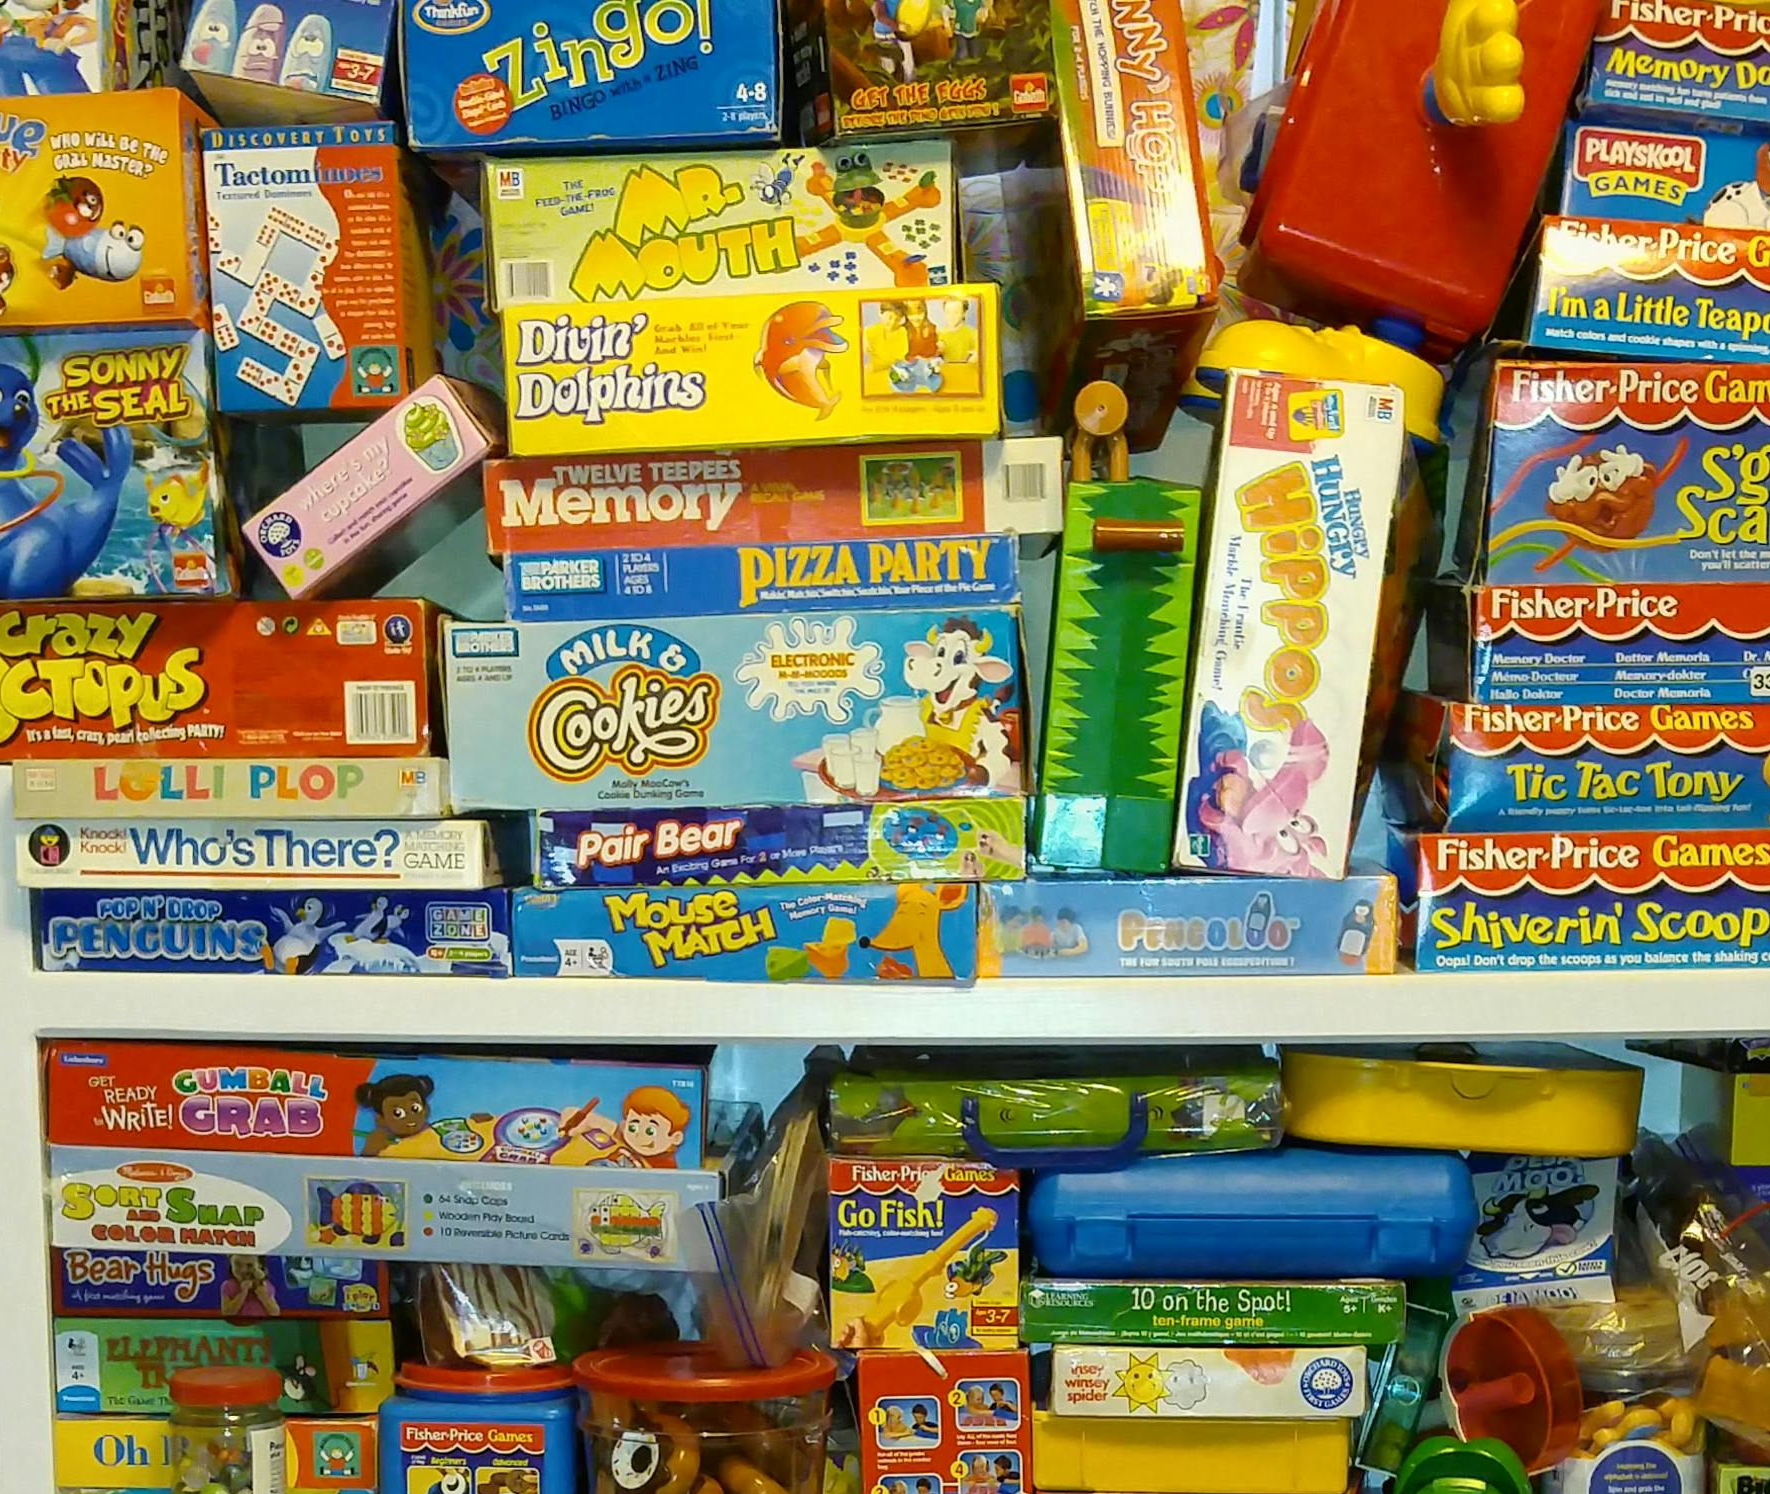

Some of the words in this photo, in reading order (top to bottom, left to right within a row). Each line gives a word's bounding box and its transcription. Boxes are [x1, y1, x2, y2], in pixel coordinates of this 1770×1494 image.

[736, 83, 767, 103] 4-8
[210, 128, 326, 148] DISCOVERY
[332, 126, 386, 145] TOYS
[214, 162, 382, 189] Tactominoes
[613, 163, 744, 249] MR.
[568, 218, 802, 302] MOUTH
[1547, 291, 1575, 319] I'm
[1579, 300, 1611, 323] a
[1616, 291, 1690, 328] Little
[516, 313, 649, 366] Divin'
[64, 348, 185, 384] SONNY
[46, 395, 92, 418] THE
[92, 376, 190, 424] SEAL
[515, 365, 706, 424] Dolphins
[1510, 371, 1699, 404] Fisher-Price
[553, 462, 641, 486] TWELVE
[647, 459, 741, 480] TEEPEES
[499, 479, 743, 531] Memory
[738, 543, 862, 607] PIZZA
[870, 539, 991, 582] PARTY
[560, 626, 654, 675] MILK
[658, 638, 687, 671] &
[536, 681, 711, 778] Cookies
[1506, 765, 1567, 803] Tic
[1575, 762, 1640, 800] Tac
[1645, 761, 1745, 802] Tony
[129, 827, 254, 868] Who's
[255, 828, 400, 868] There?
[404, 853, 466, 870] GAME
[577, 827, 644, 868] Pair
[654, 818, 741, 856] Bear
[1436, 835, 1640, 871] Fisher-Price
[603, 890, 739, 932] Mouse
[1430, 902, 1625, 949] Shiverin'
[640, 911, 777, 967] MATCH
[173, 1066, 328, 1100] GUMBALL
[179, 1096, 325, 1137] GRAB
[439, 1226, 450, 1238] 10
[454, 1227, 501, 1239] Reversible
[503, 1229, 535, 1241] Picture
[538, 1231, 570, 1243] Cards
[837, 1200, 874, 1229] Go
[879, 1199, 944, 1228] Fish!
[64, 1251, 139, 1284] Bear
[145, 1251, 215, 1301] Hugs
[1130, 1289, 1155, 1312] 10
[1162, 1293, 1189, 1312] on
[1196, 1288, 1230, 1313] the
[1237, 1289, 1292, 1314] Spot!
[1152, 1314, 1222, 1328] ten-frame
[1224, 1316, 1264, 1329] game
[1064, 1377, 1110, 1390] winsey
[1067, 1390, 1108, 1404] spider
